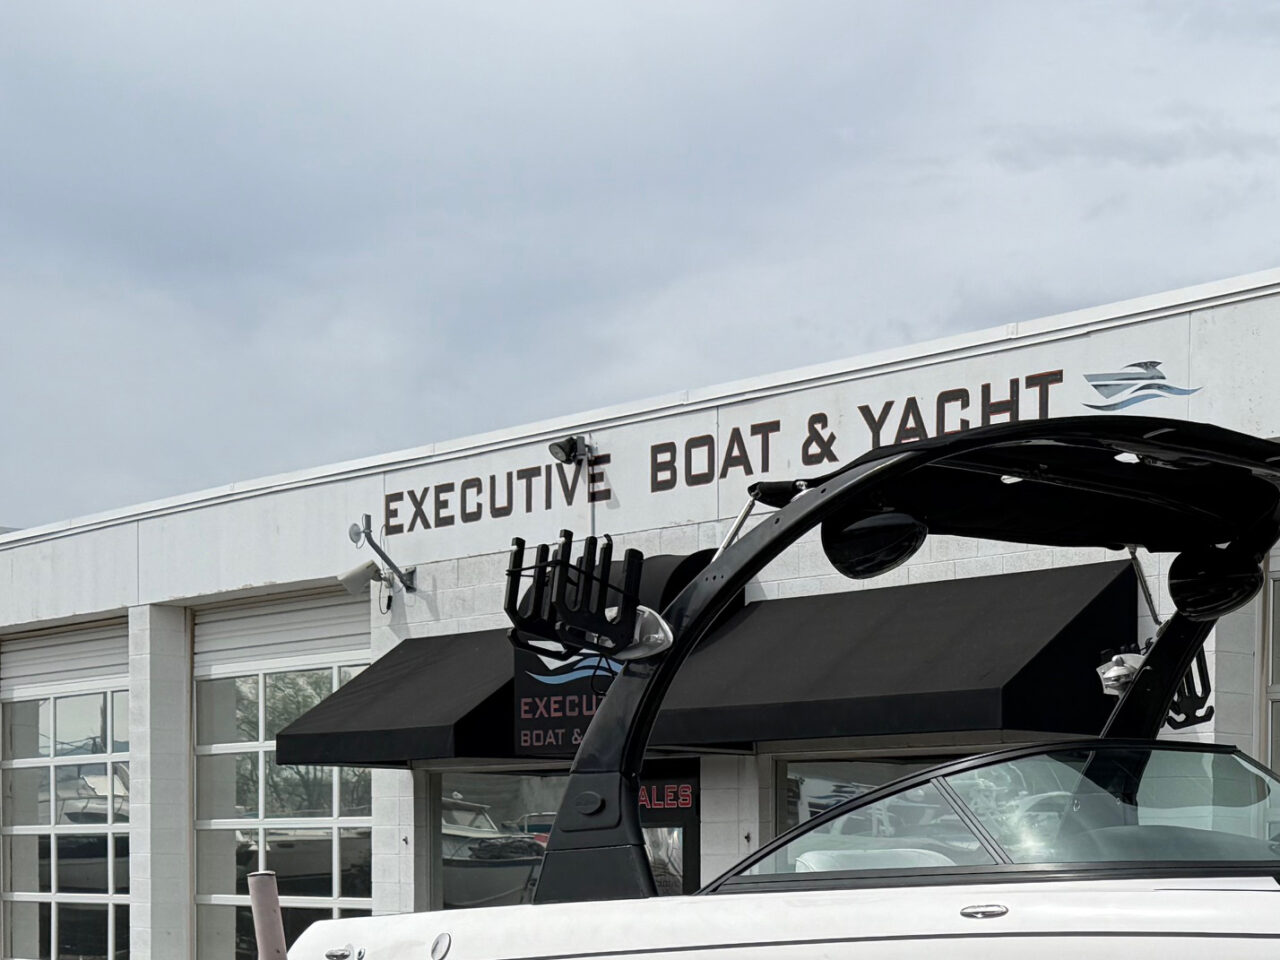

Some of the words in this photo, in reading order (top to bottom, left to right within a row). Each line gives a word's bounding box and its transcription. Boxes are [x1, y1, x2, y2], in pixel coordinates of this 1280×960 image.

[385, 453, 611, 536] EXECUTIVE
[650, 419, 781, 494] BOAT
[801, 412, 840, 466] &
[857, 369, 1064, 450] YACHT
[520, 694, 604, 719] EXECU
[520, 728, 566, 747] BOAT
[571, 727, 584, 745] &
